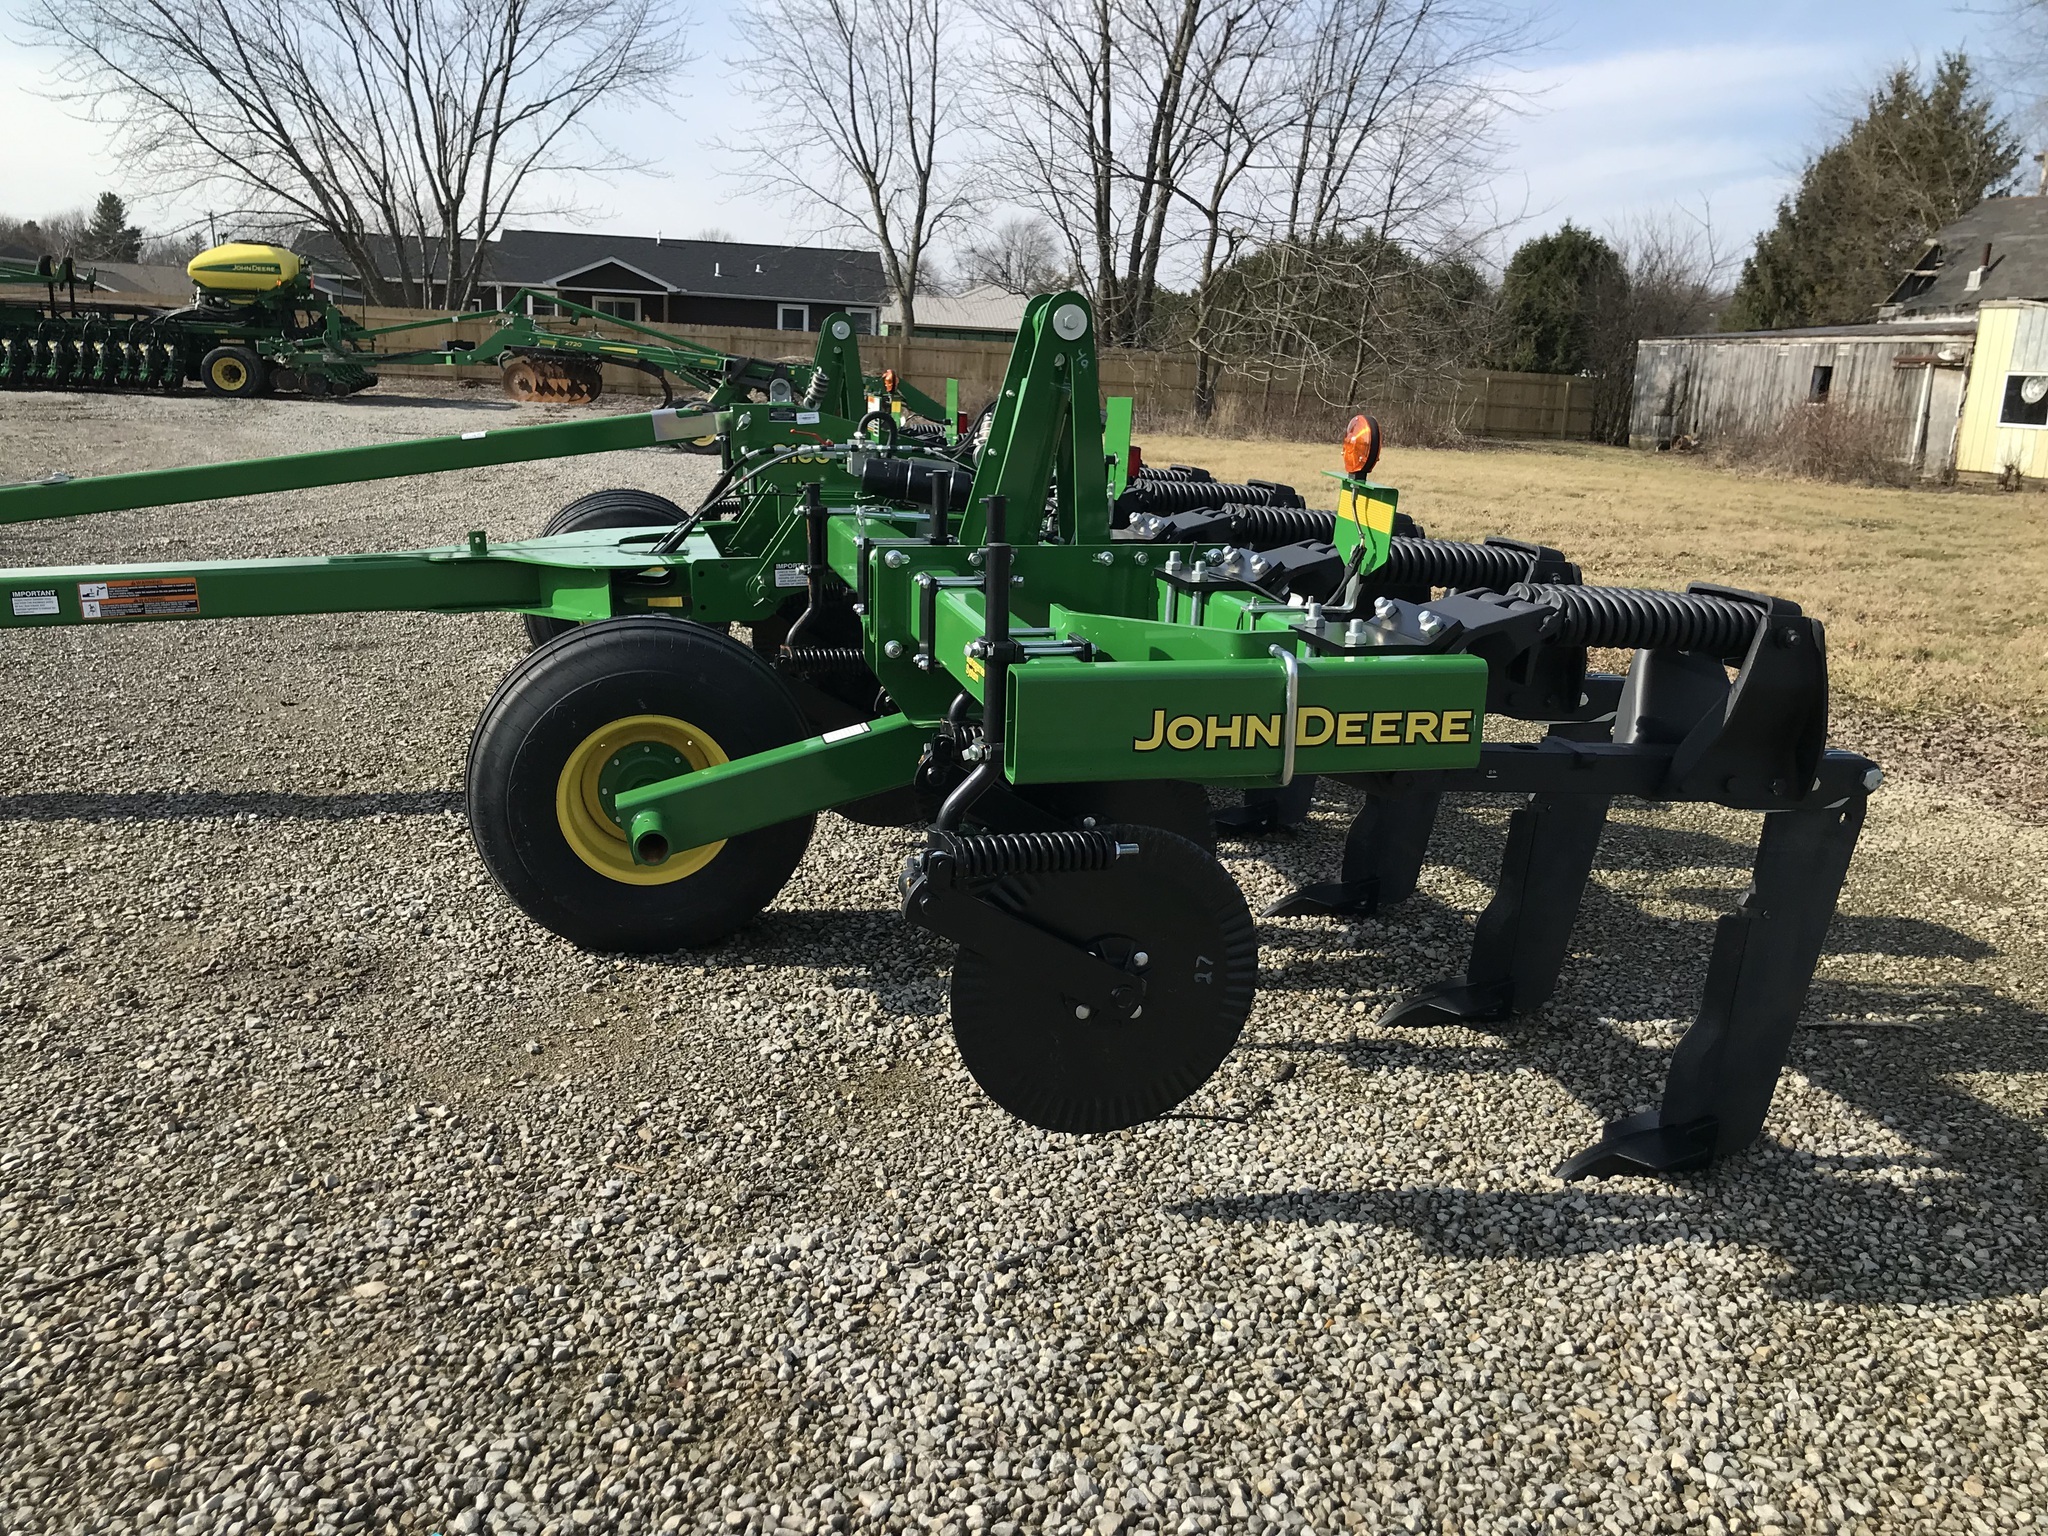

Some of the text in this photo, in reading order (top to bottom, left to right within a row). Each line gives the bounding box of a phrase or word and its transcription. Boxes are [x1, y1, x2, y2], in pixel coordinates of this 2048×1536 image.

[564, 340, 583, 348] 2720
[12, 590, 56, 598] IMPORTANT
[1133, 706, 1474, 751] JOHN DEERE
